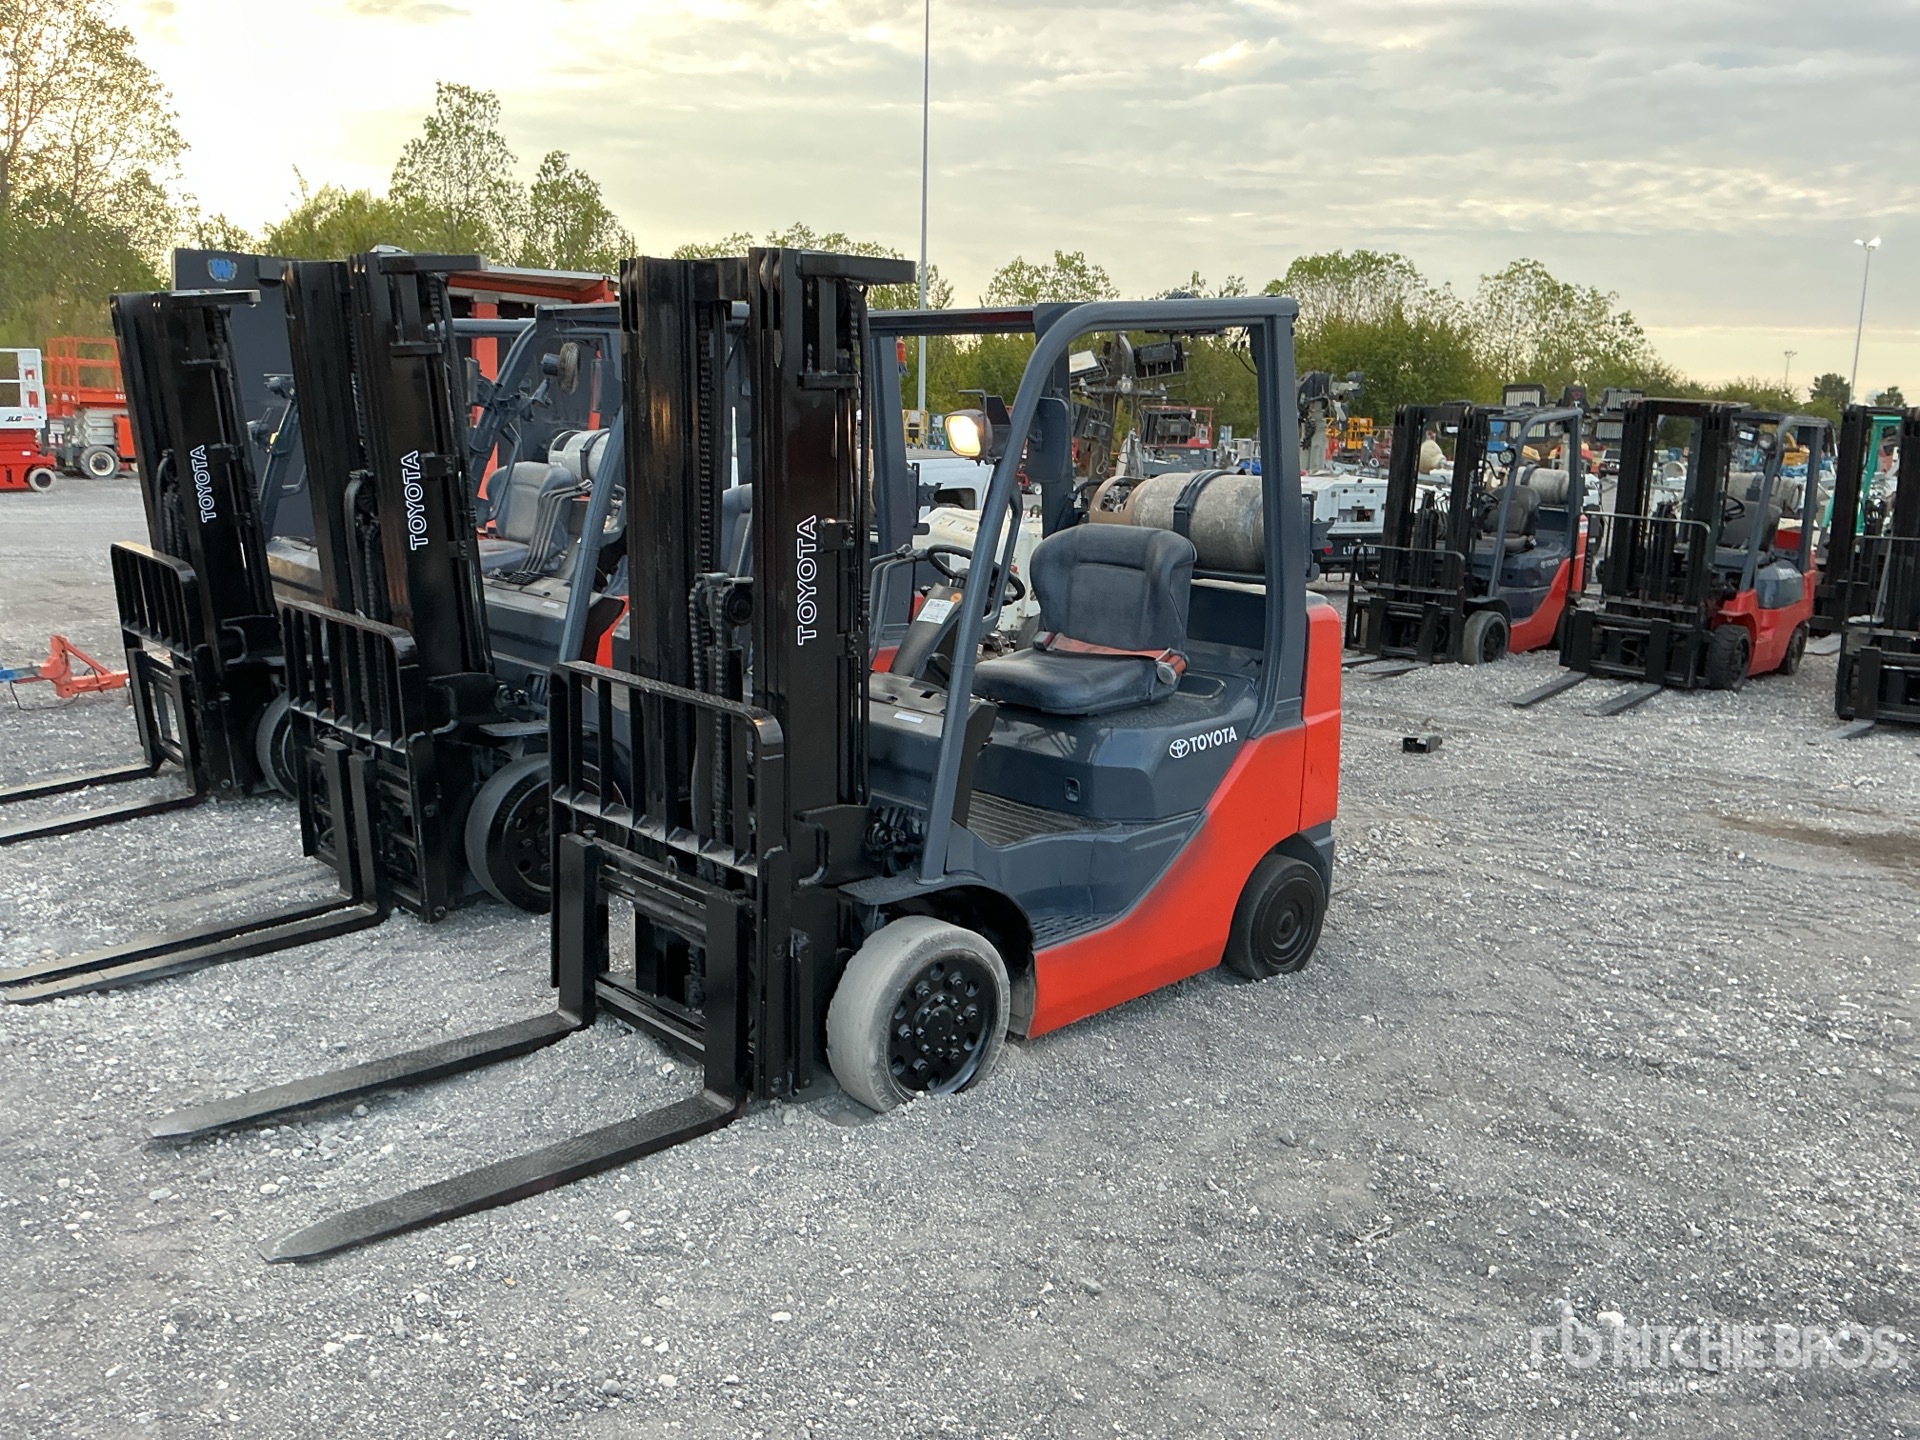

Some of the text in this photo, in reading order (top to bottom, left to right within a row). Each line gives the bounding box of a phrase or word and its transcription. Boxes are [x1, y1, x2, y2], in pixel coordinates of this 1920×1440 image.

[190, 444, 217, 523] TOYOTA
[400, 450, 429, 551] TOYOTA
[796, 514, 817, 646] TOYOTA
[1189, 726, 1238, 753] TOYOTA
